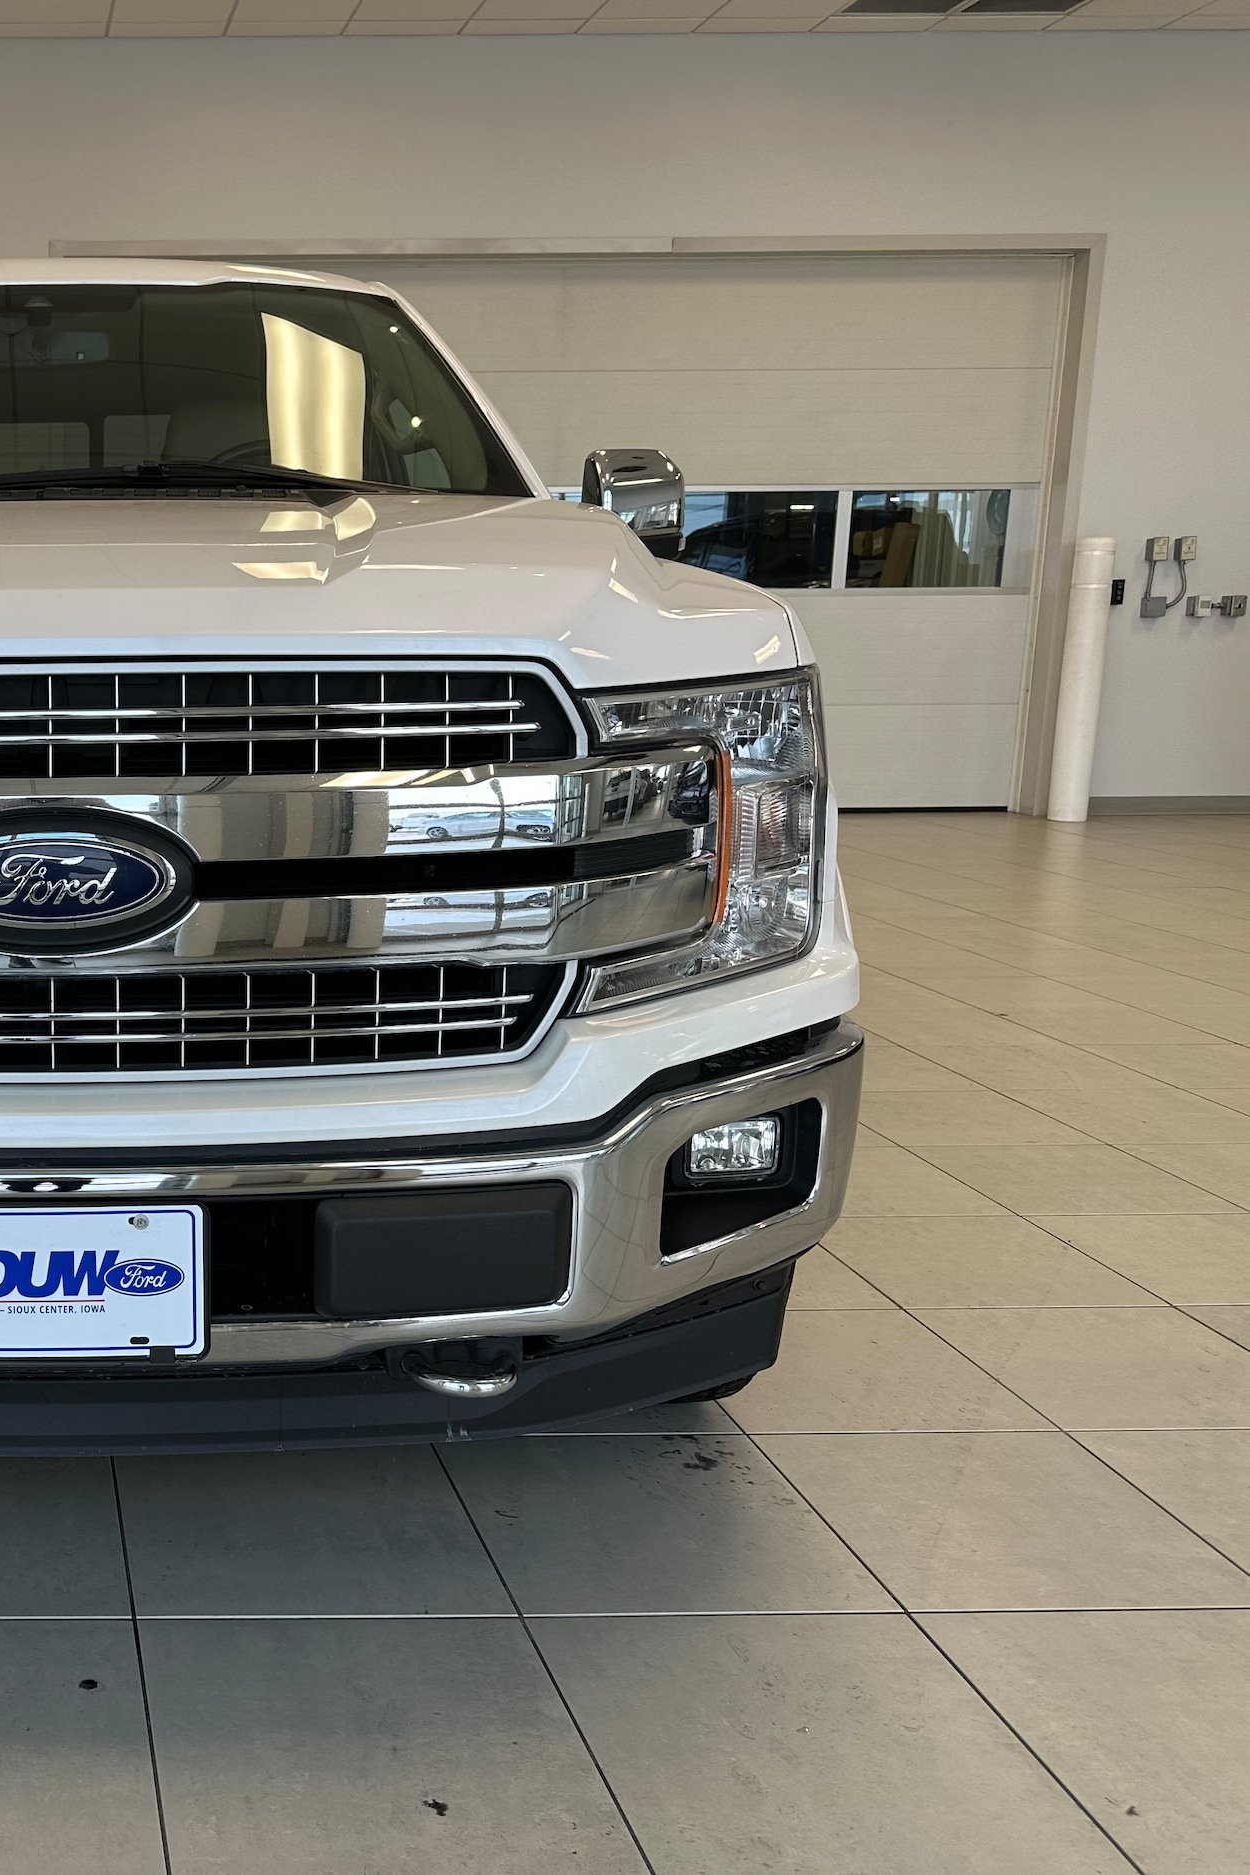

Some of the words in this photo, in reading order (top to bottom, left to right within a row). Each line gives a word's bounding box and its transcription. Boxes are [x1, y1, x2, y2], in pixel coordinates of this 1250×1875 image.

[120, 1264, 166, 1288] Ford
[7, 1305, 36, 1314] SIOUX
[80, 1304, 106, 1313] IOWA
